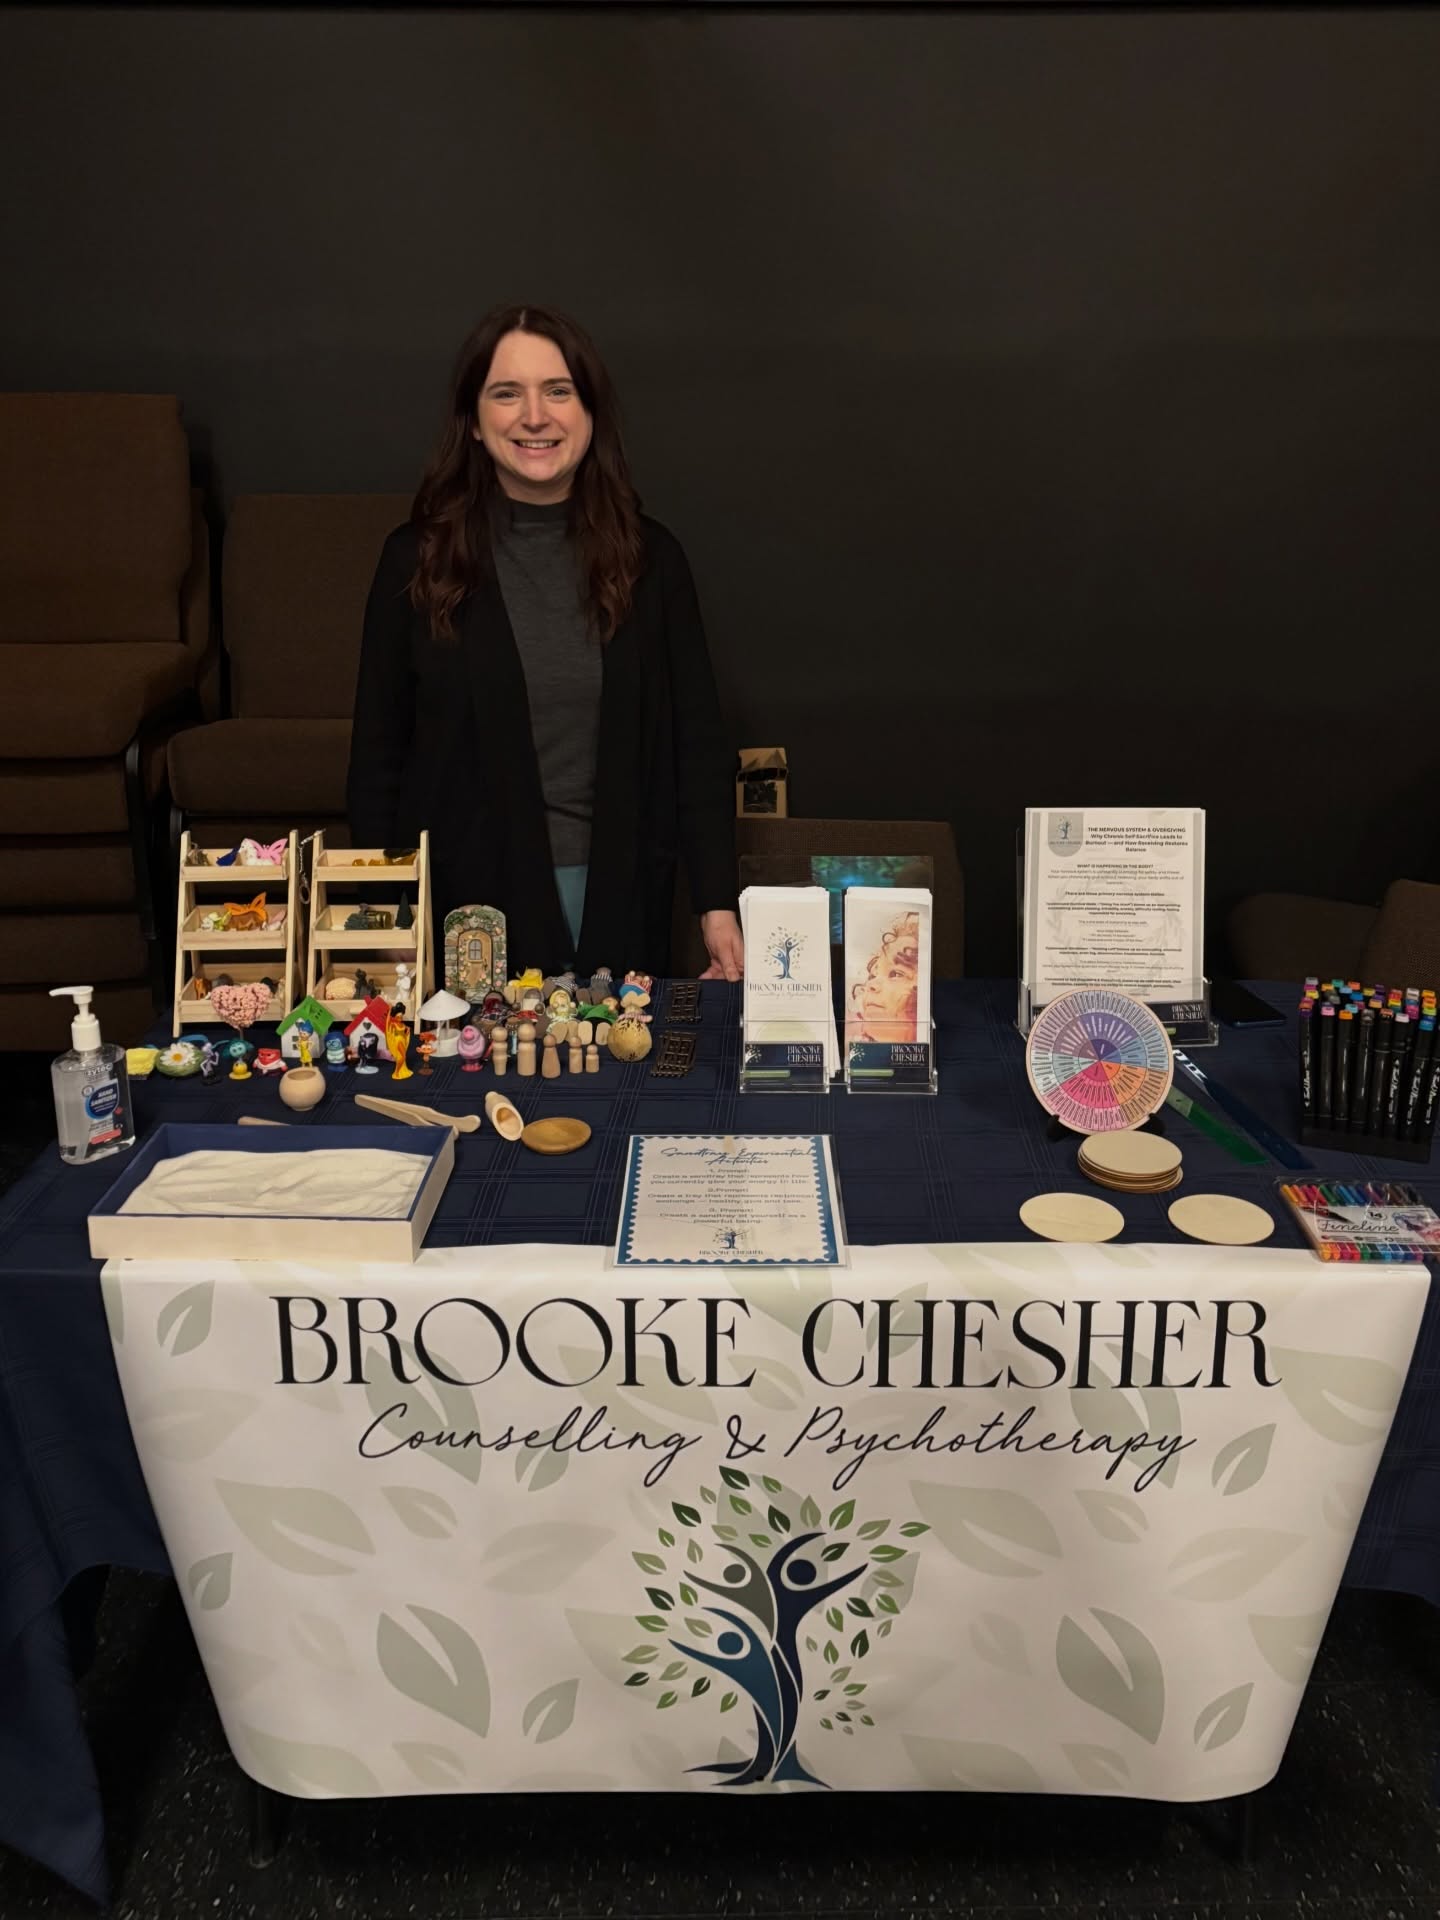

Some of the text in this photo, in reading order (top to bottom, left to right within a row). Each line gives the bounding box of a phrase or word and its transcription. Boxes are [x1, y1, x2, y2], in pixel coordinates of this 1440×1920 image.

[750, 983, 822, 992] BROOKE CHESHER
[891, 1045, 924, 1054] BROOKE
[891, 1054, 924, 1062] CHESHER
[705, 1155, 768, 1165] Activities
[1320, 1220, 1399, 1231] Fineline
[268, 1295, 1283, 1389] BROOKE CHESHER
[357, 1402, 1198, 1493] Counselling & Psychotherapy
